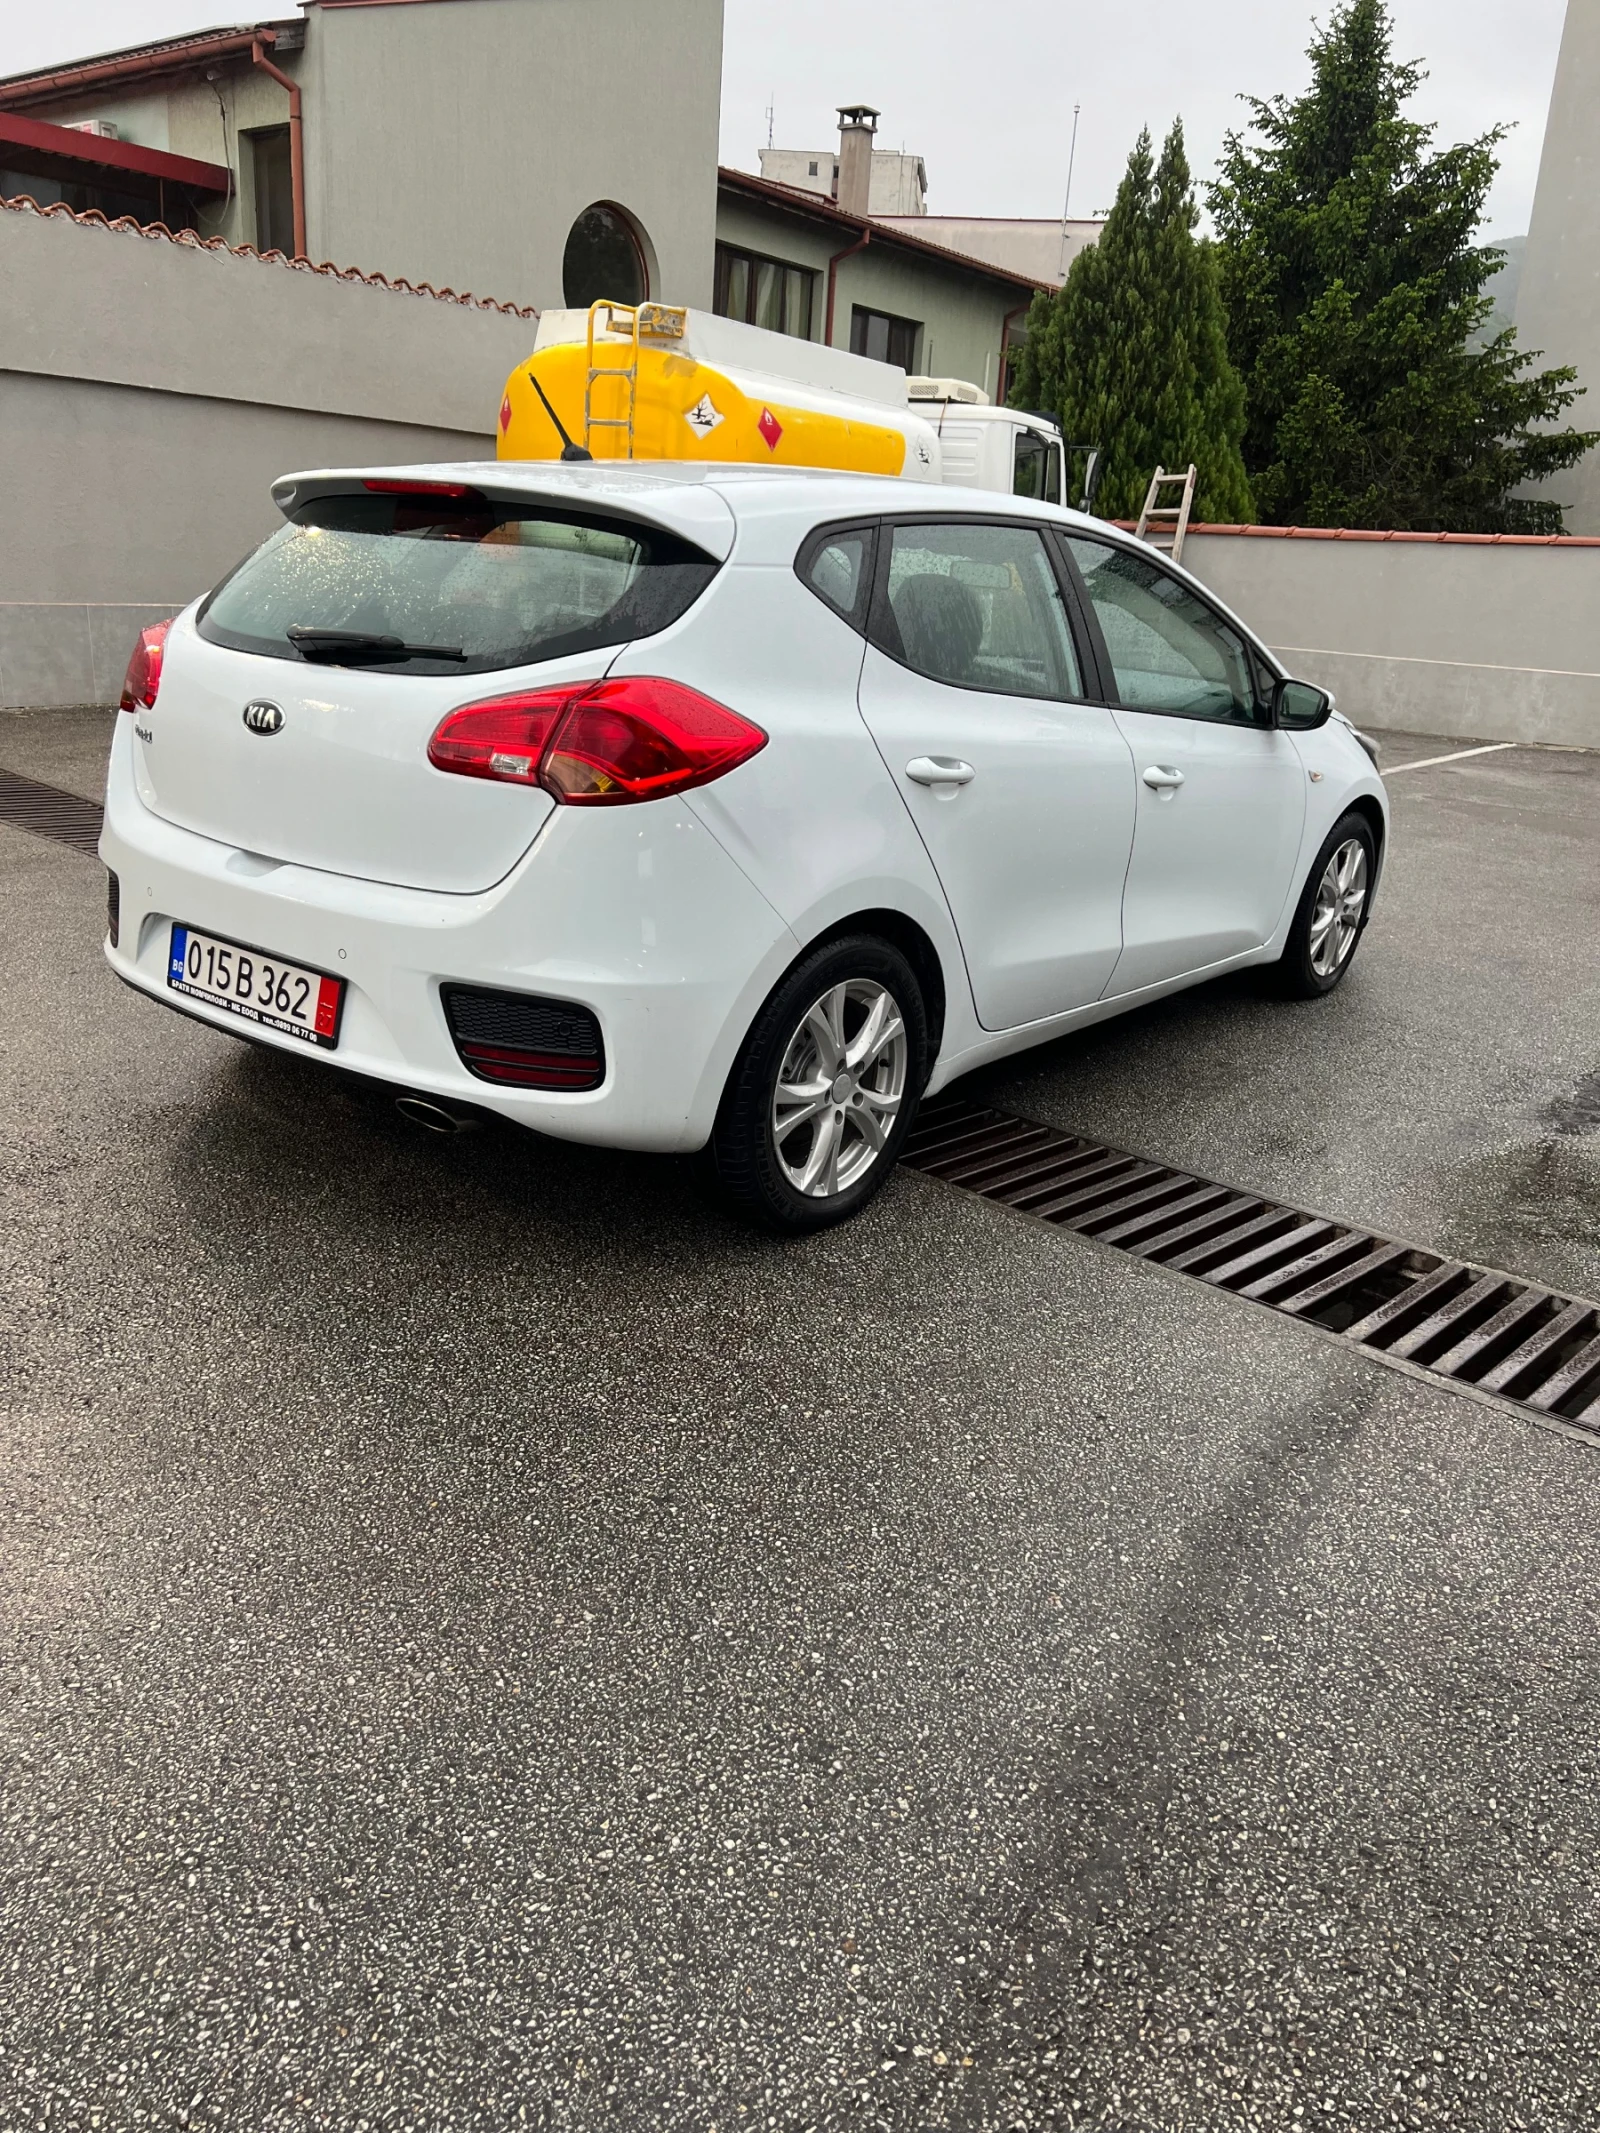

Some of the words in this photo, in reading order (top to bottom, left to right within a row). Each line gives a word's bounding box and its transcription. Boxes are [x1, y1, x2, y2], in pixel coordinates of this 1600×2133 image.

[246, 705, 275, 730] KIA
[172, 958, 183, 973] BG
[171, 979, 190, 993] БРАТЯ
[241, 1006, 259, 1021] ЕООД
[291, 1025, 300, 1036] 06
[300, 1028, 309, 1039] 77
